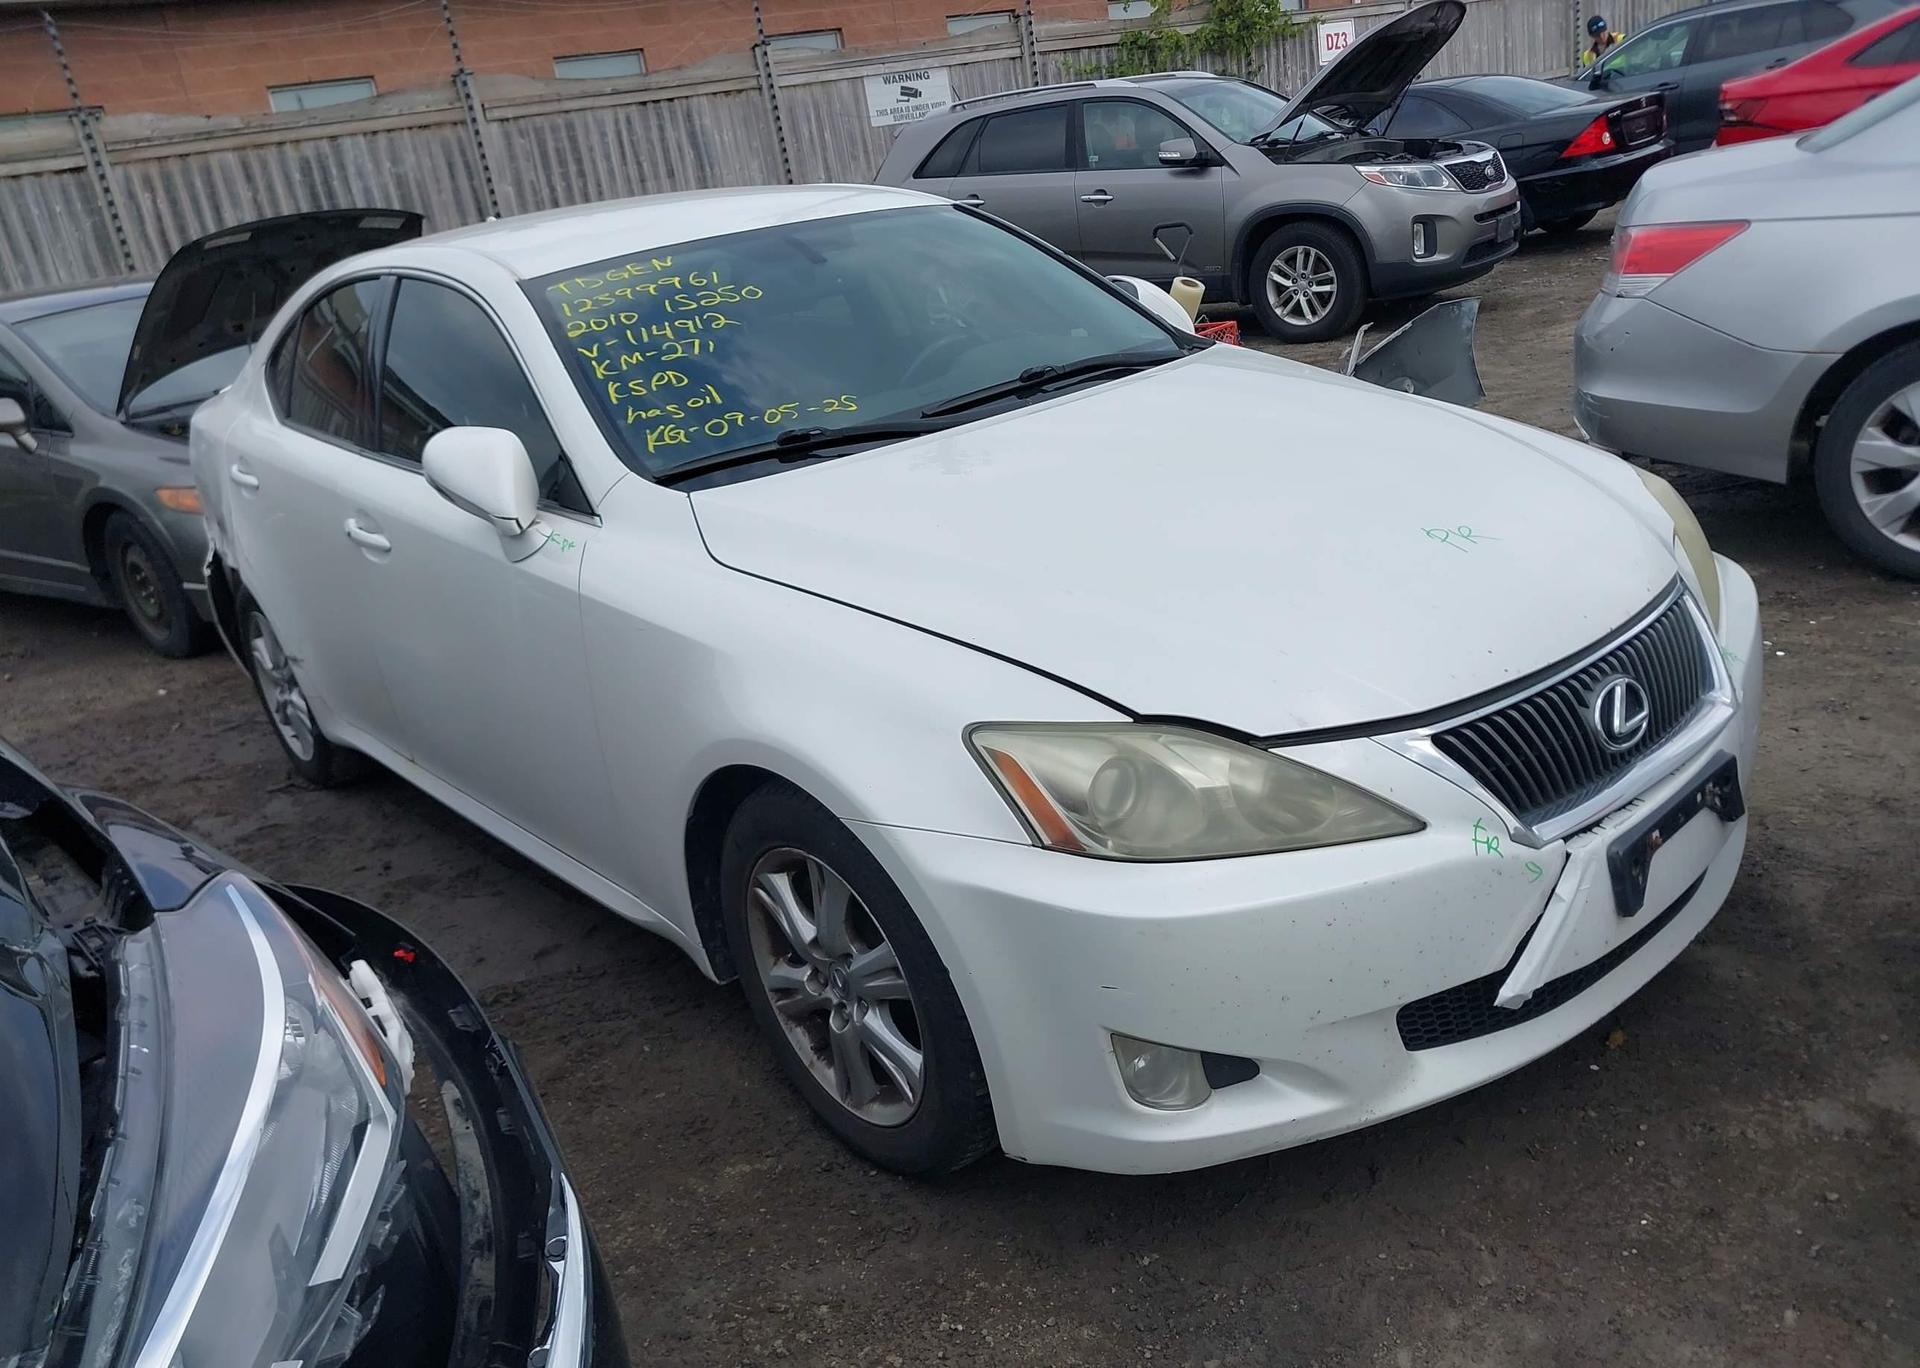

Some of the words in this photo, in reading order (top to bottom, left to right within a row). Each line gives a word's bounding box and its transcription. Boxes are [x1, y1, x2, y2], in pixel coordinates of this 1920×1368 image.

[1326, 32, 1348, 50] DZ3
[882, 71, 930, 85] WARNING
[876, 109, 889, 118] THIS
[890, 106, 904, 115] AREA
[904, 105, 911, 113] IS
[911, 103, 930, 112] UNDER
[567, 312, 638, 338] 2010
[626, 404, 685, 425] has
[687, 384, 722, 408] oil
